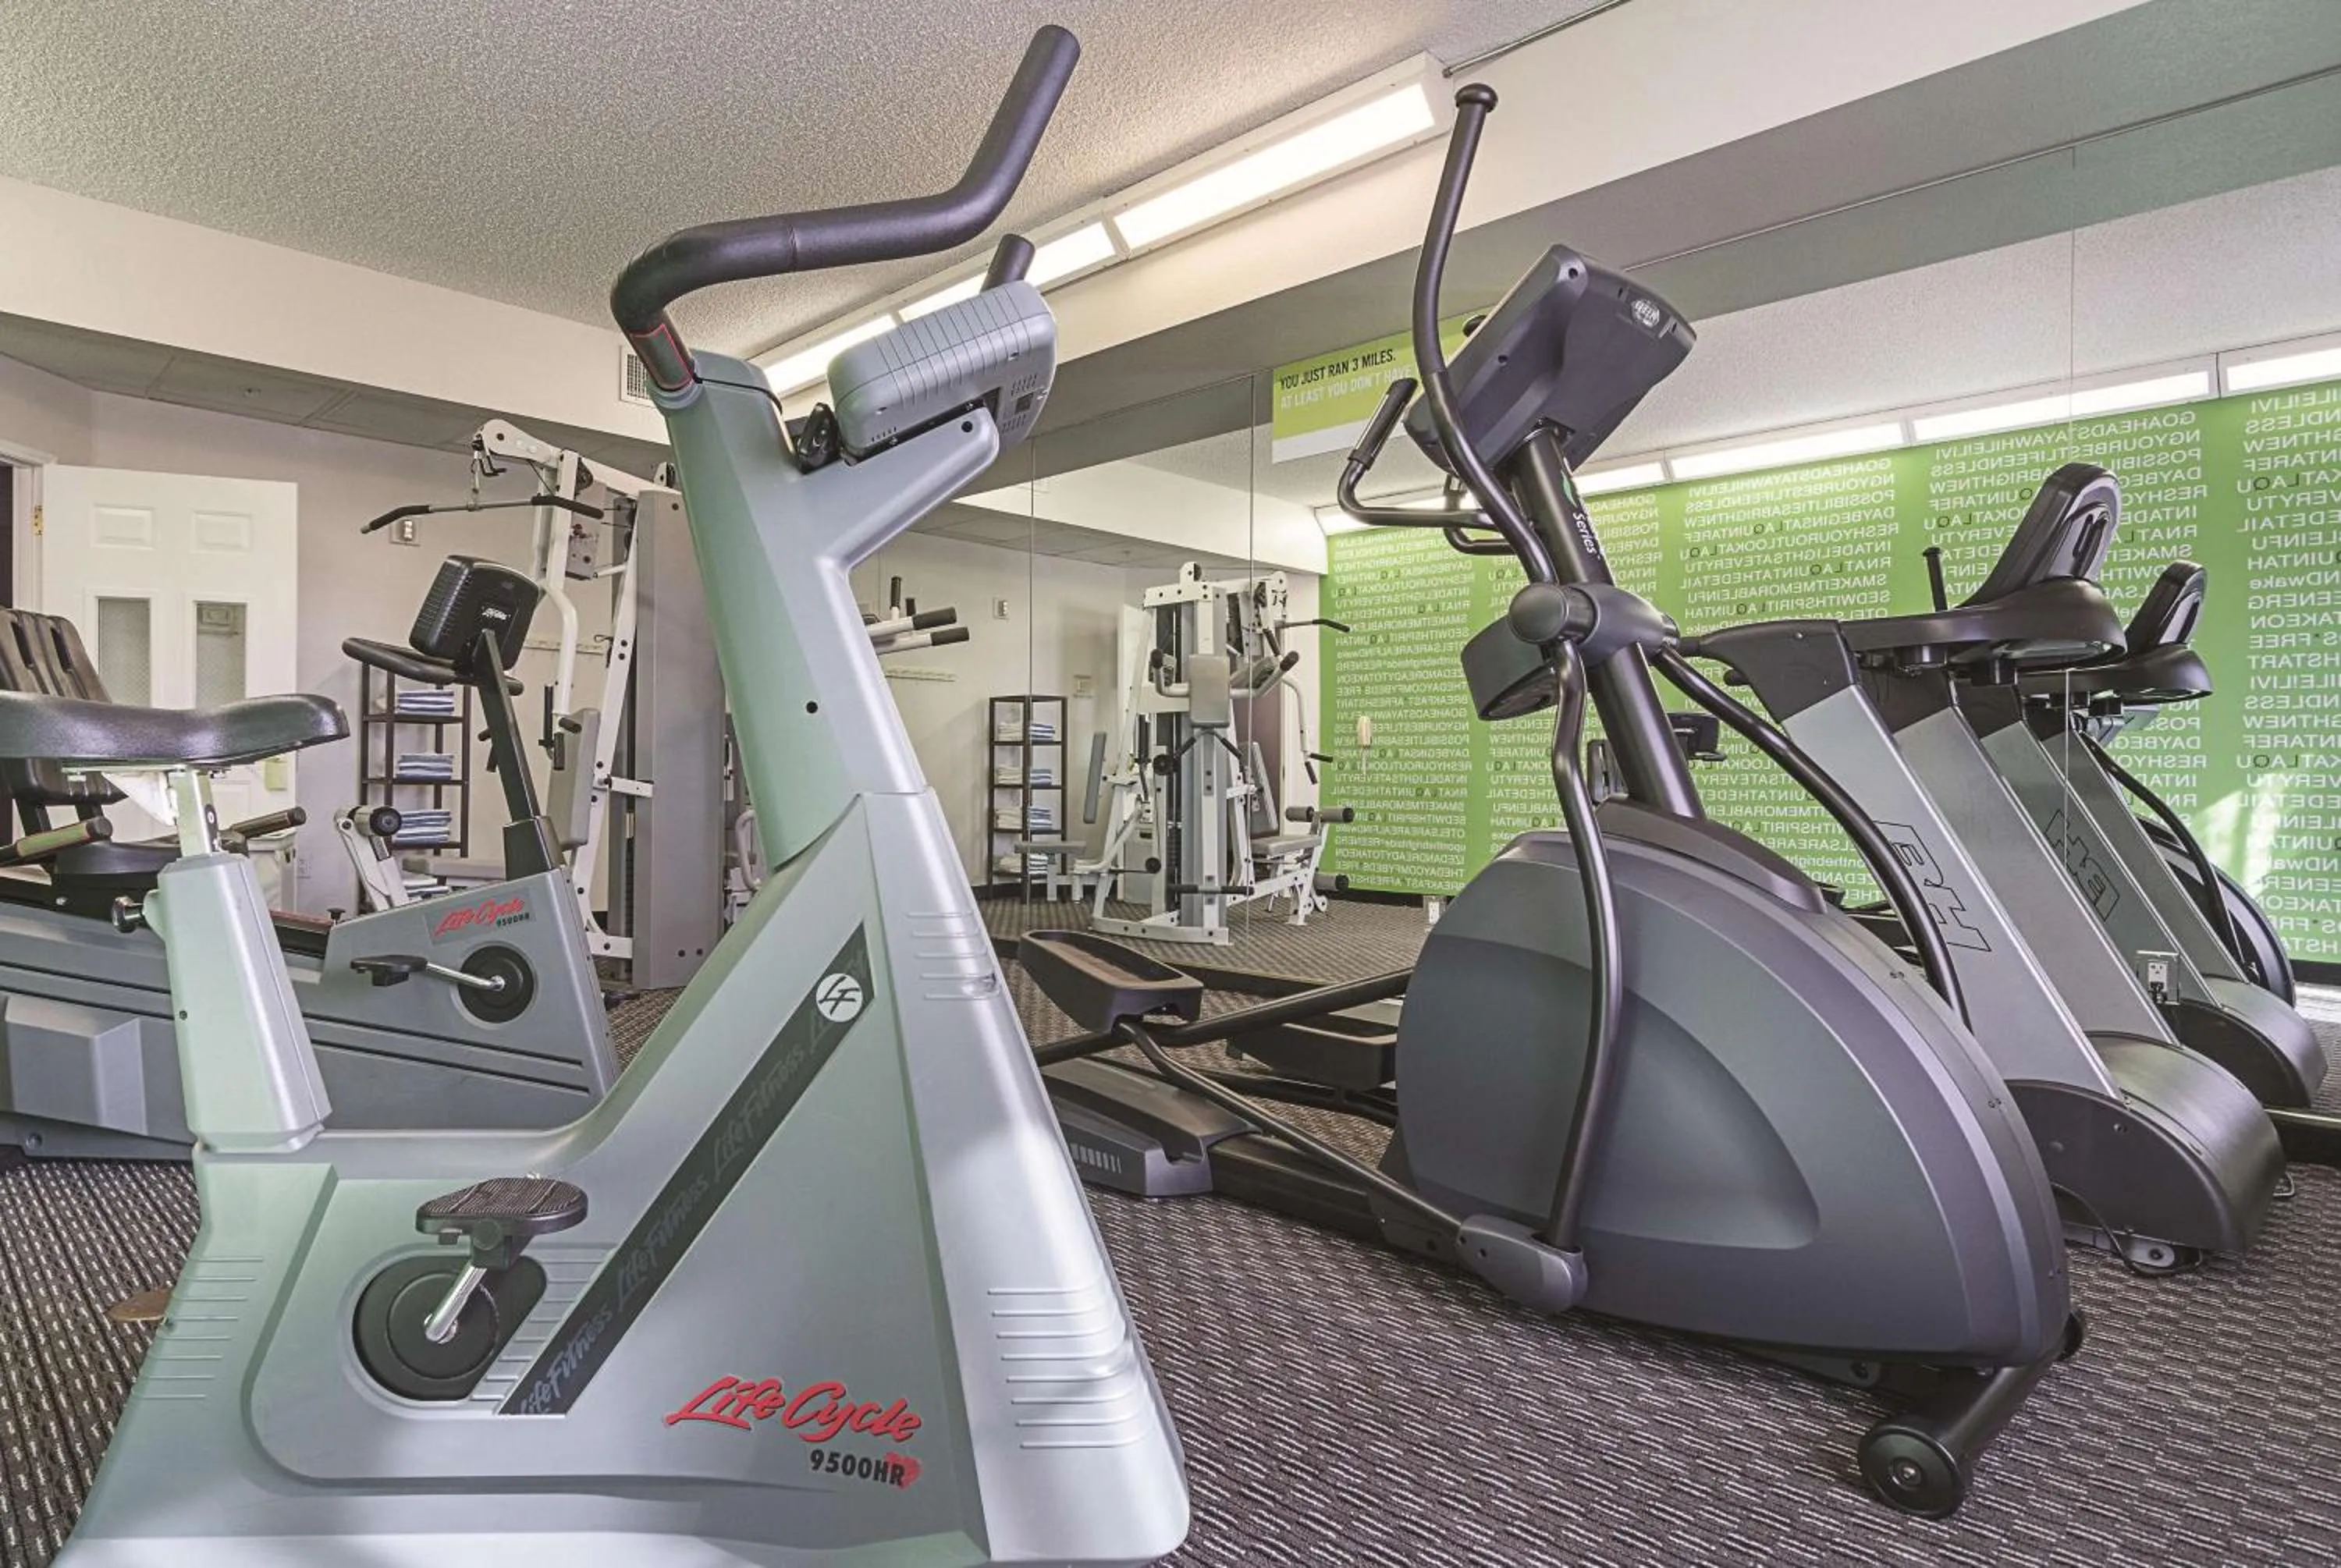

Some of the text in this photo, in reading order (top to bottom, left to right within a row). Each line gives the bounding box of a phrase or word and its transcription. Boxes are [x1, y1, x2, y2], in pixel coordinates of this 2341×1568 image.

[1281, 349, 1396, 390] YOU JUST RAN 3 MILES.
[1281, 394, 1292, 410] AT
[1295, 386, 1324, 406] LEAST
[1327, 379, 1348, 399] YOU
[810, 1449, 906, 1487] 9500HR
